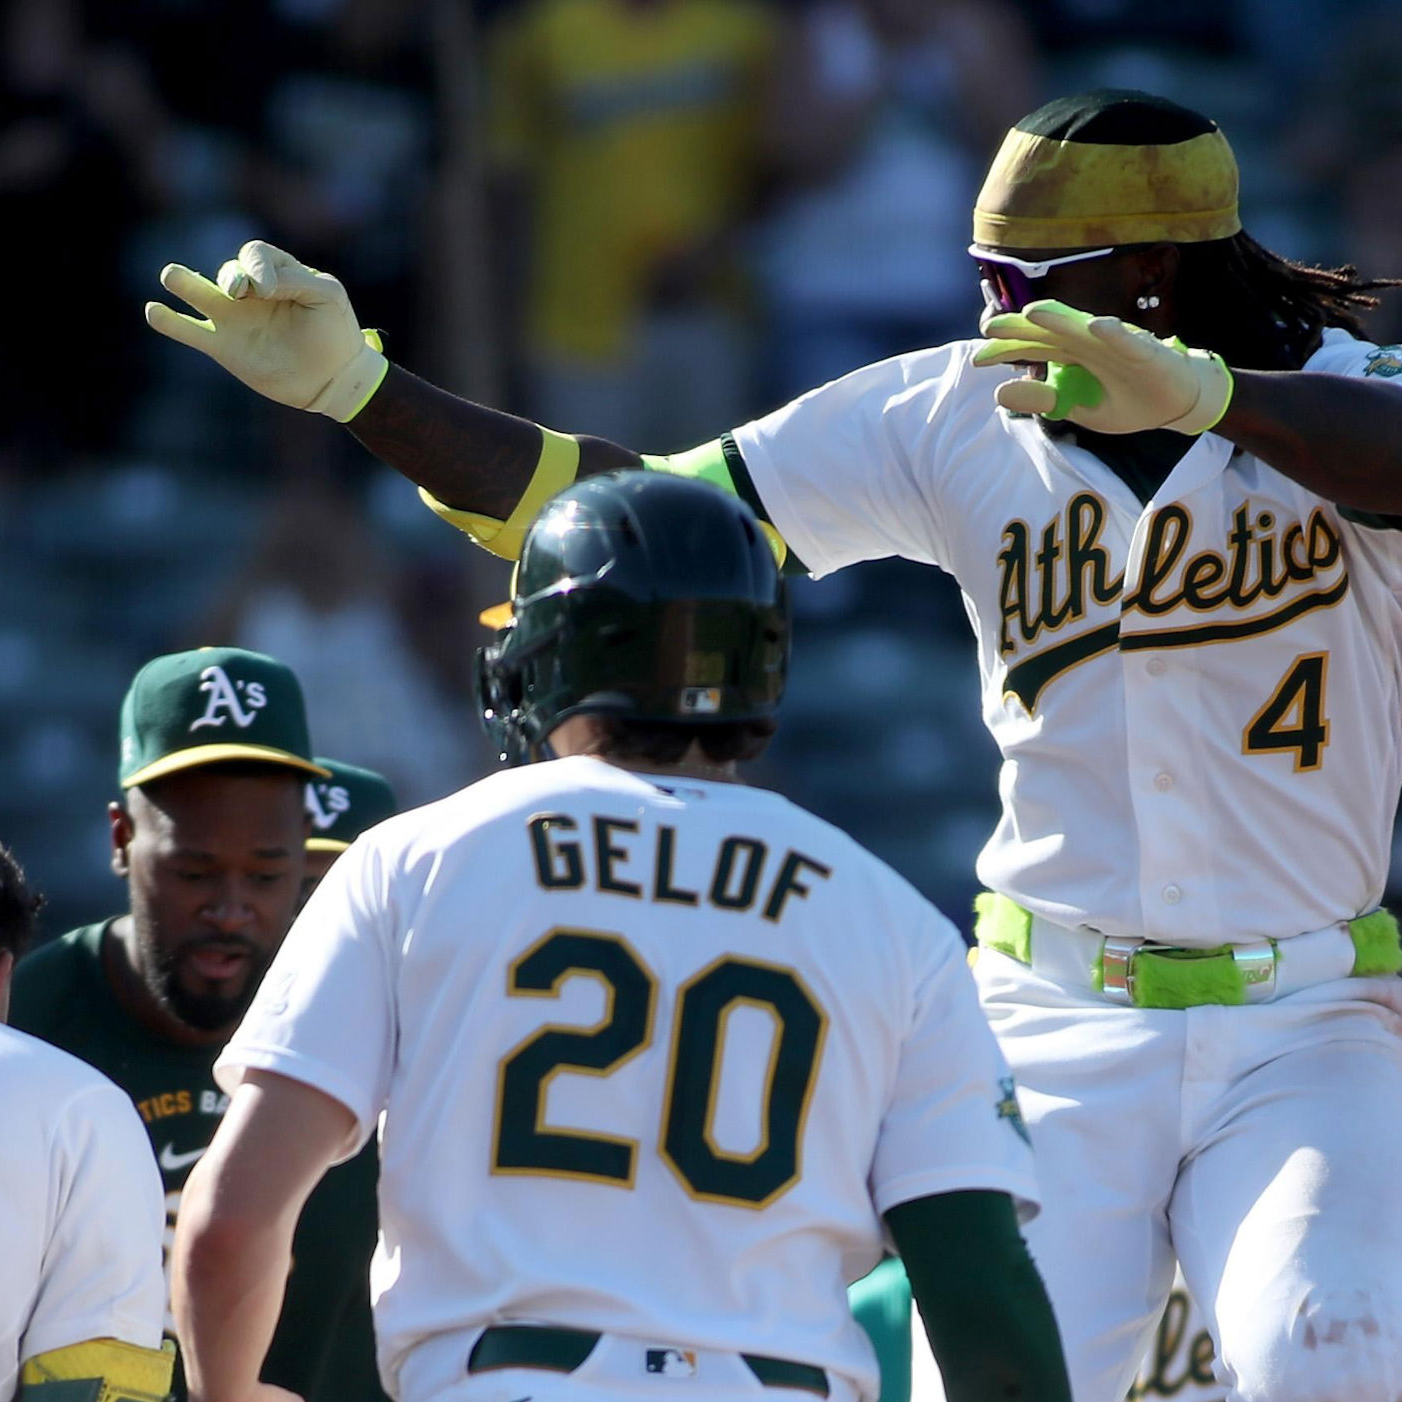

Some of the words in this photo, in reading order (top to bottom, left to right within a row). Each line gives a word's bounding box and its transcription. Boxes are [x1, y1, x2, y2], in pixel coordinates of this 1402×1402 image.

[998, 490, 1342, 660] Athletics
[191, 665, 268, 732] A's
[1241, 649, 1331, 773] 4
[526, 810, 834, 924] GELOF
[489, 925, 830, 1211] 20
